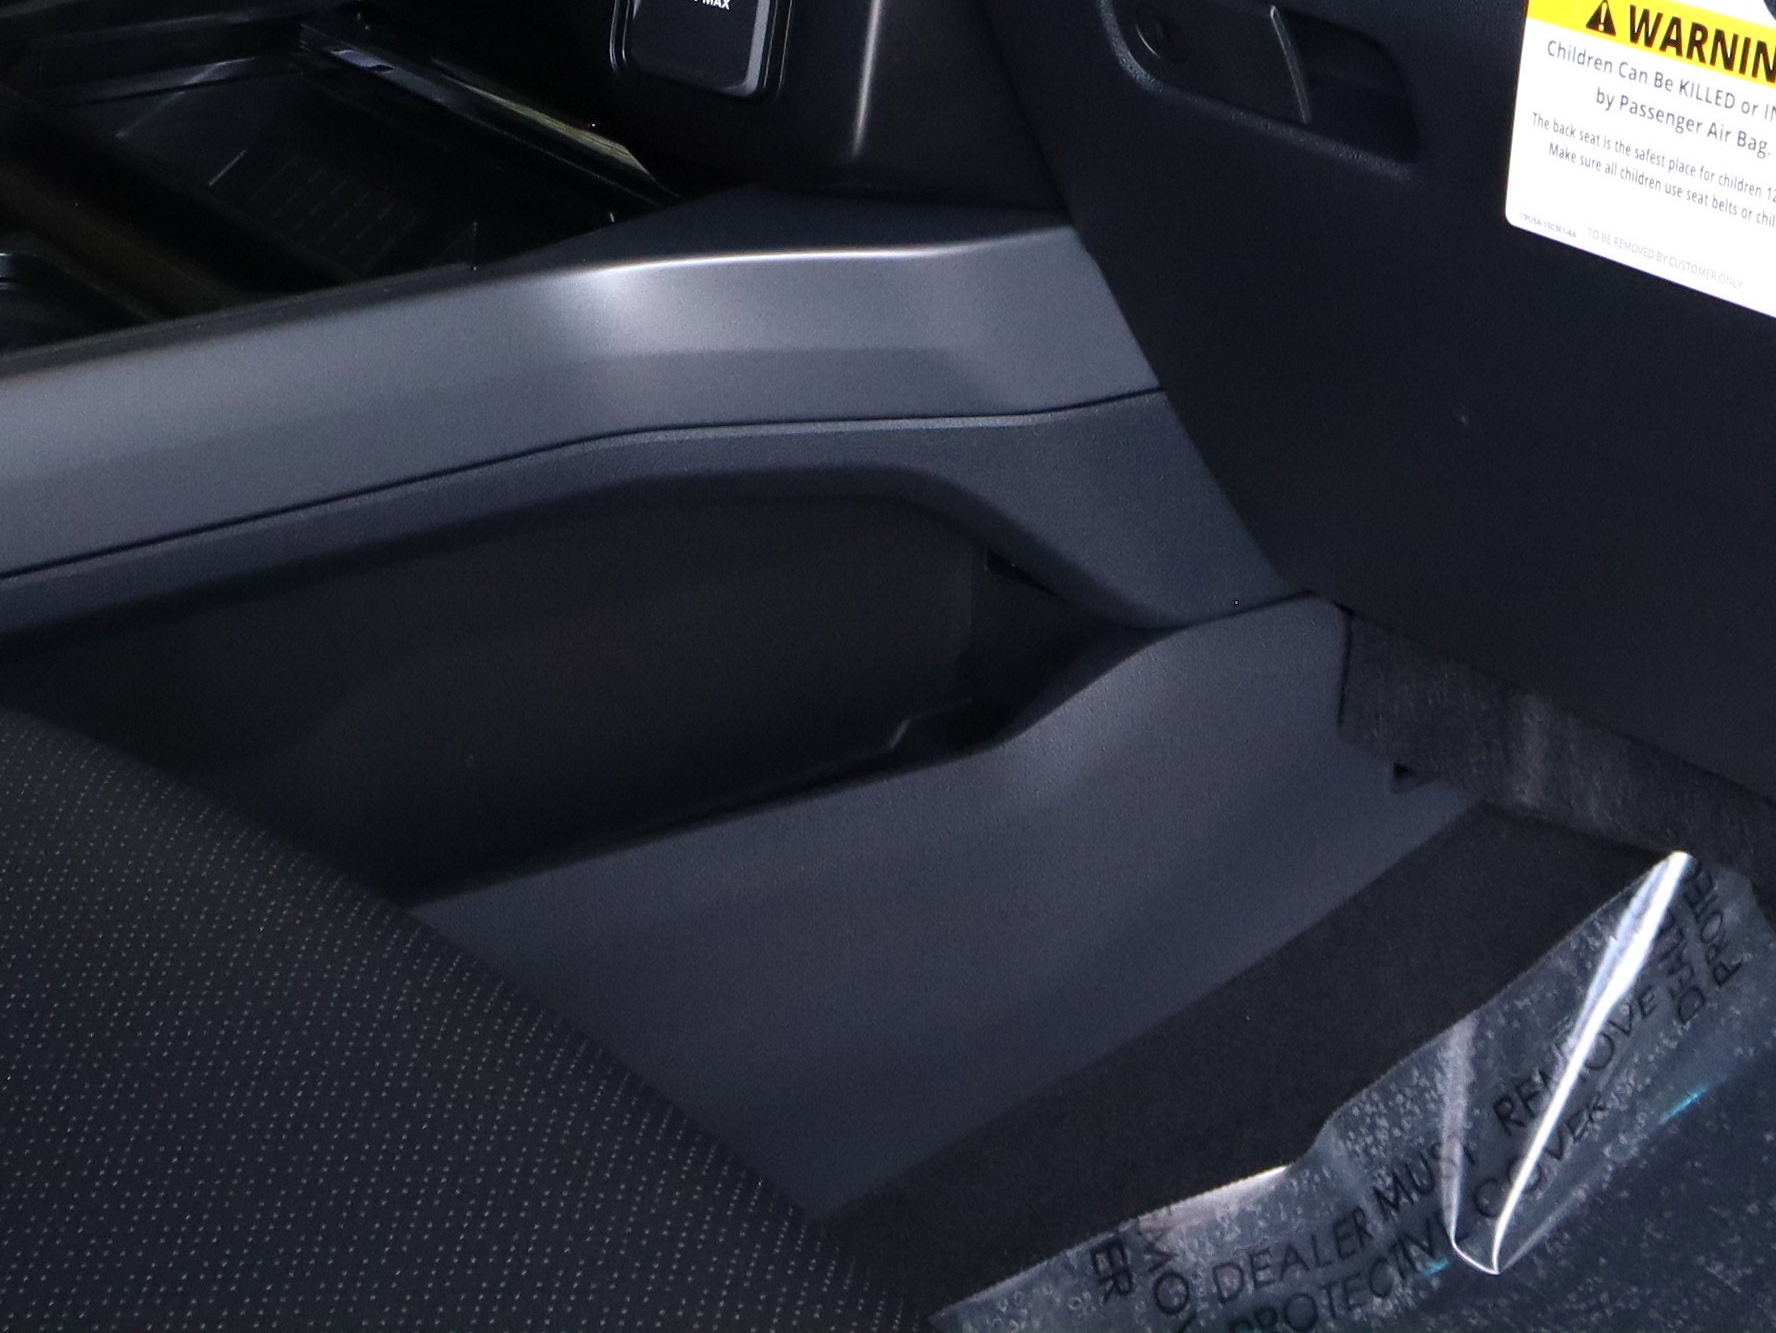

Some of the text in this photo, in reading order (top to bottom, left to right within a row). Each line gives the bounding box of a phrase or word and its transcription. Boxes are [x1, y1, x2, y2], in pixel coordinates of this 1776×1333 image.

[1547, 39, 1613, 74] Children
[1618, 61, 1649, 84] Can
[1653, 70, 1674, 93] Be
[1678, 78, 1736, 110] KILLED
[1740, 100, 1760, 116] or
[1531, 111, 1551, 131] The
[1552, 118, 1577, 140] back
[1578, 129, 1601, 147] seat
[1602, 135, 1612, 151] is
[1614, 139, 1632, 157] the
[1633, 147, 1666, 168] safest
[1667, 156, 1697, 178] place
[1699, 164, 1716, 183] for
[1717, 172, 1762, 199] children
[1595, 86, 1771, 160] by Passenger Air Bag.
[1548, 141, 1577, 164] Make
[1579, 154, 1602, 172] sure
[1604, 161, 1618, 177] all
[1619, 165, 1662, 192] children
[1664, 182, 1684, 199] use
[1685, 189, 1709, 207] seat
[1711, 193, 1738, 216] belts
[1740, 207, 1754, 221] or
[1212, 1206, 1374, 1305] DEALER
